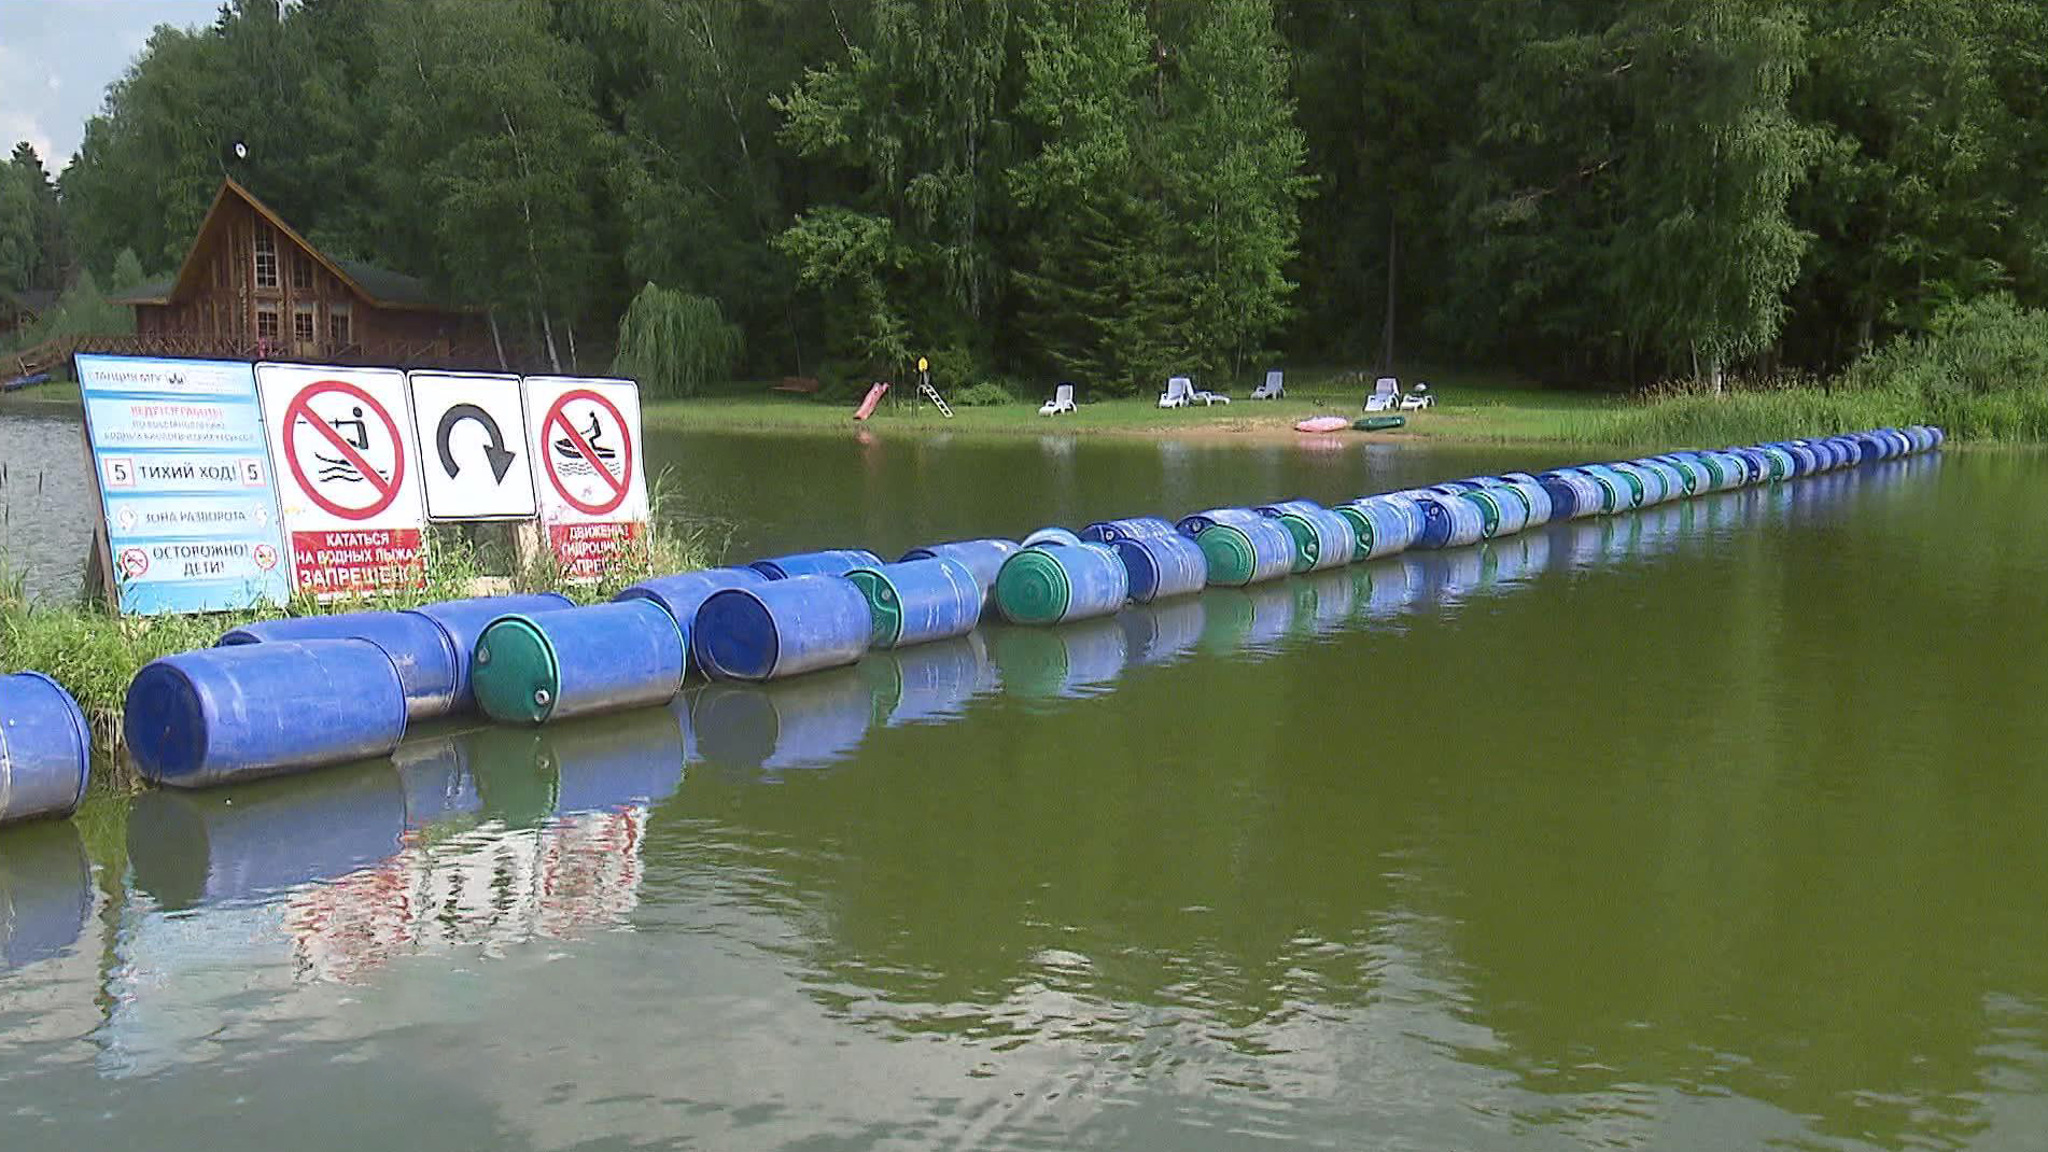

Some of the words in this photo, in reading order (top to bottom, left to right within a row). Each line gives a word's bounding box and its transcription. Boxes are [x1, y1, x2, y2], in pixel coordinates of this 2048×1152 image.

[114, 464, 127, 482] 5
[139, 462, 195, 480] ТИХИЙ
[200, 464, 237, 482] ХОД!
[247, 464, 259, 481] 5
[325, 532, 390, 547] КАТАТЬСЯ
[295, 550, 315, 565] НА
[184, 561, 225, 577] ДЕТИ!
